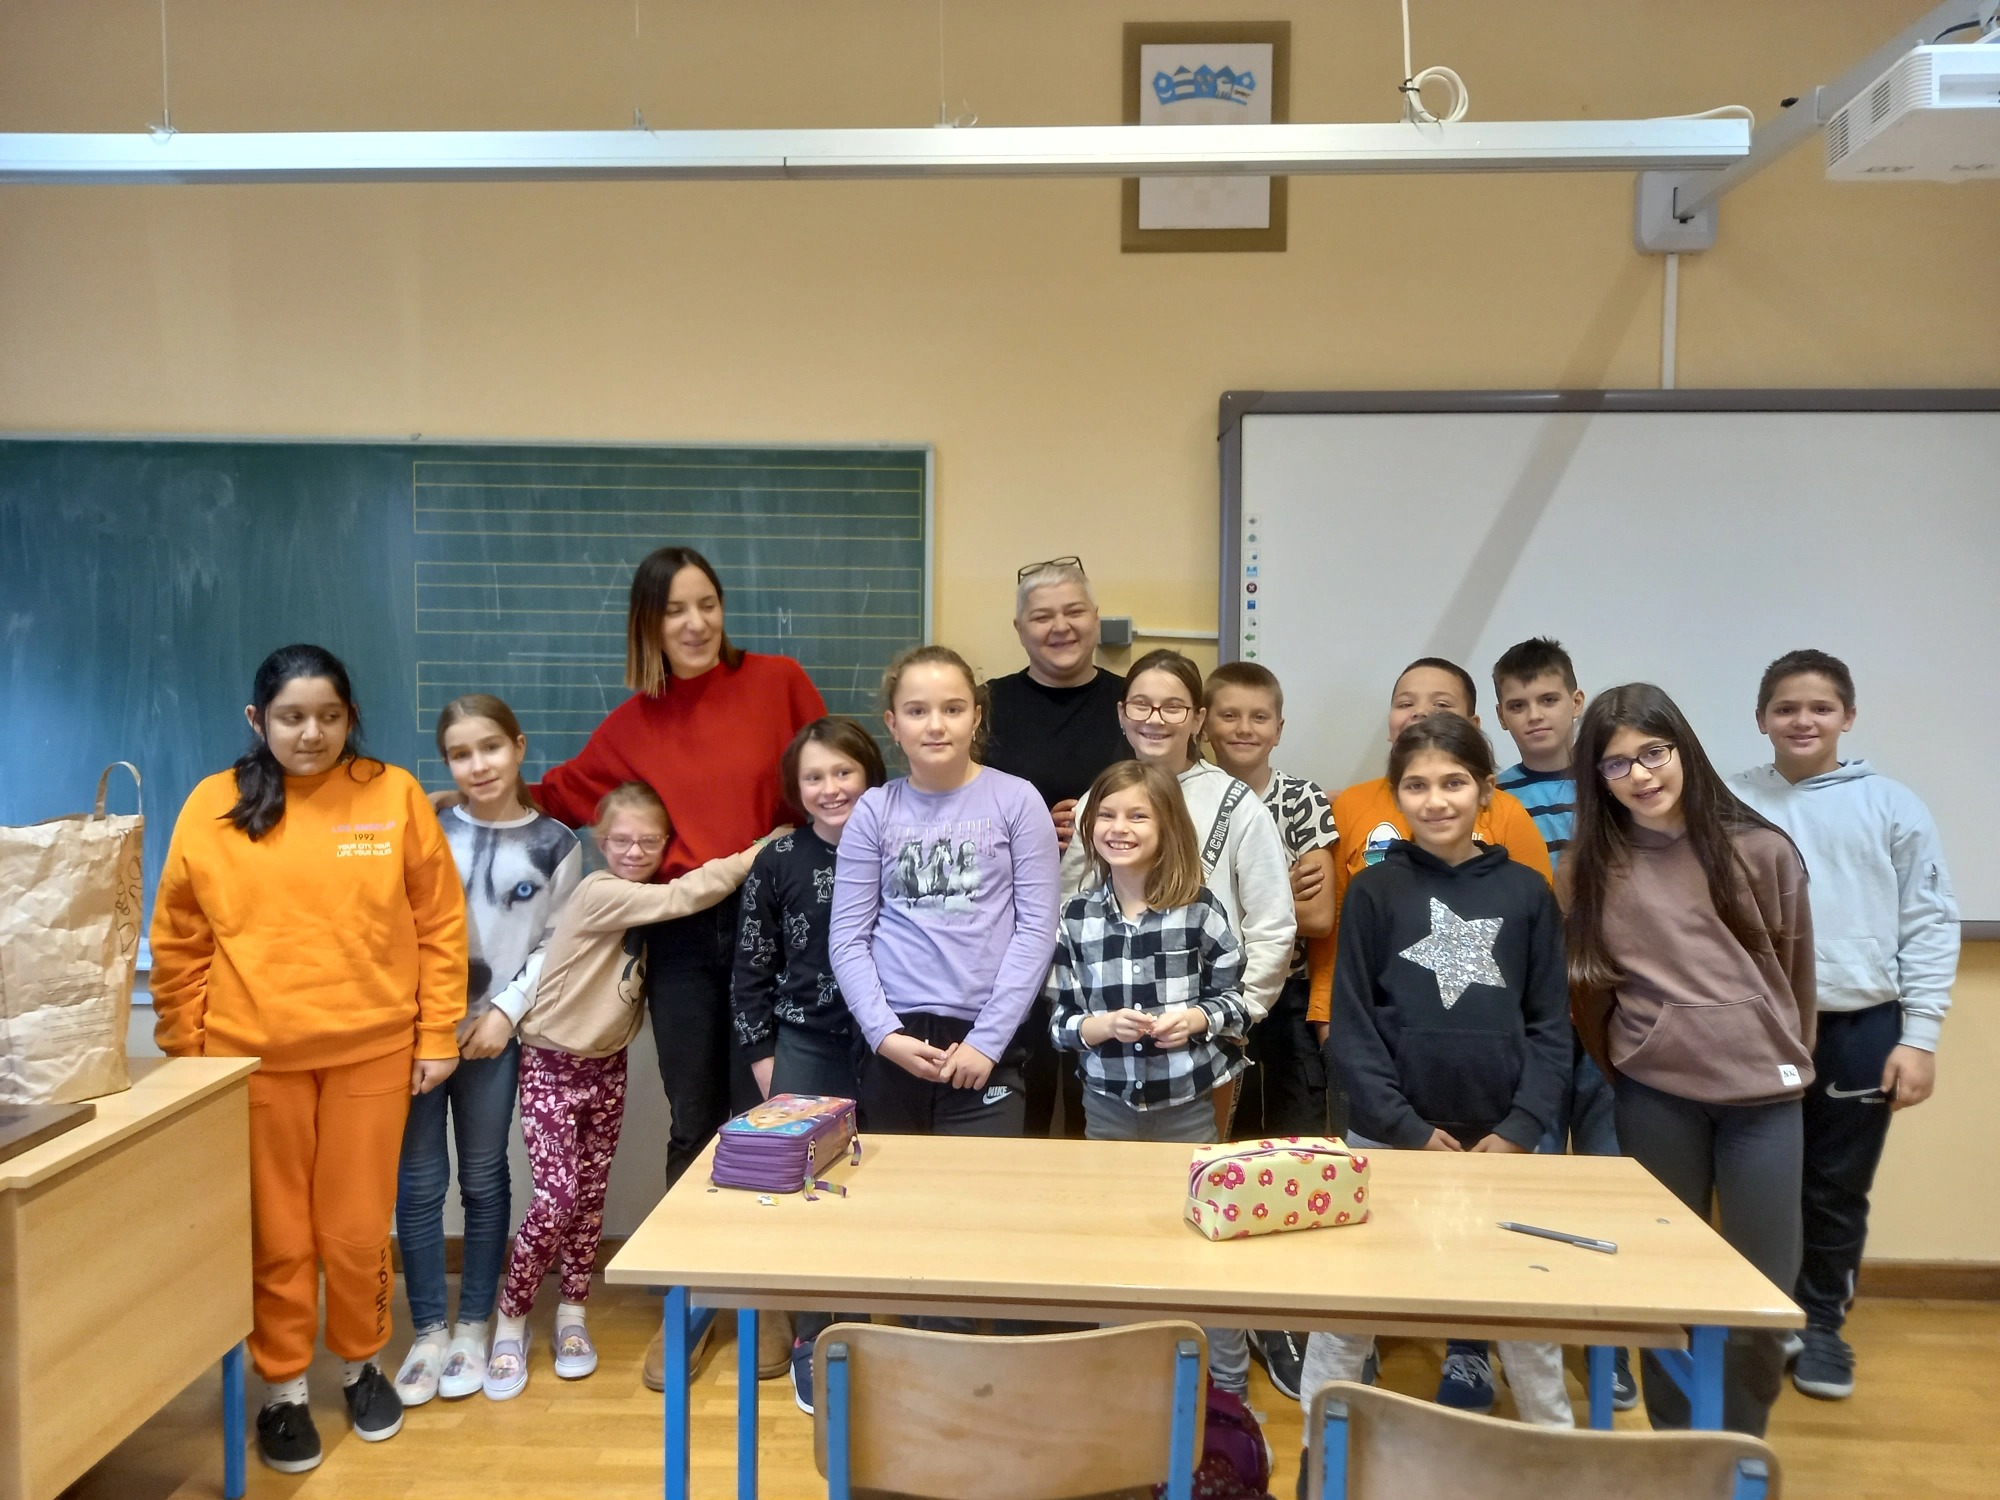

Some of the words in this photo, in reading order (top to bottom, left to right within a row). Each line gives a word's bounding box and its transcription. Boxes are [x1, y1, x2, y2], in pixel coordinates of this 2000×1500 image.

[332, 824, 351, 833] LOS
[354, 821, 396, 831] ANGELES
[1209, 810, 1231, 850] CHILL
[372, 847, 392, 856] RULES
[987, 1085, 1008, 1097] NIKE
